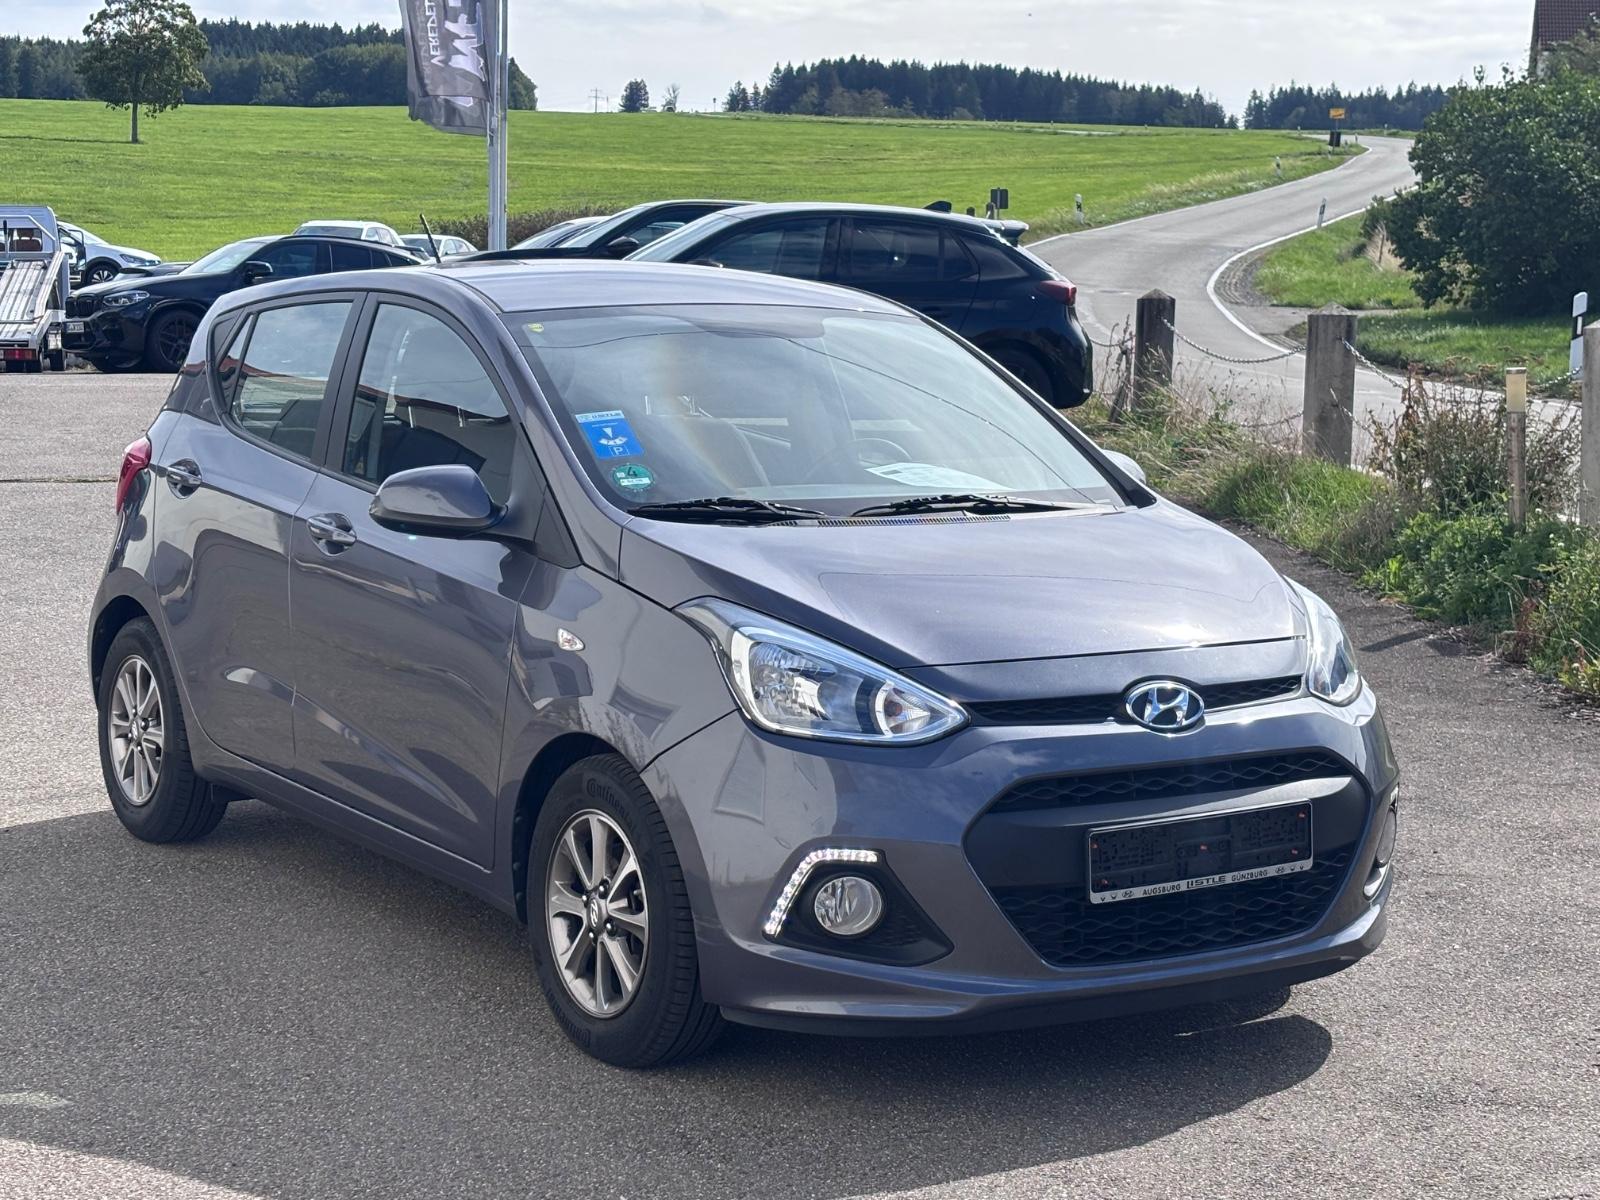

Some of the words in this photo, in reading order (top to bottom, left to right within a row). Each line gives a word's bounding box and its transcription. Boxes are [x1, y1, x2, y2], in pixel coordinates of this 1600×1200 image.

[627, 466, 638, 477] 4
[1142, 883, 1181, 896] AUGSBURG
[1231, 869, 1268, 882] GÜNZBURG
